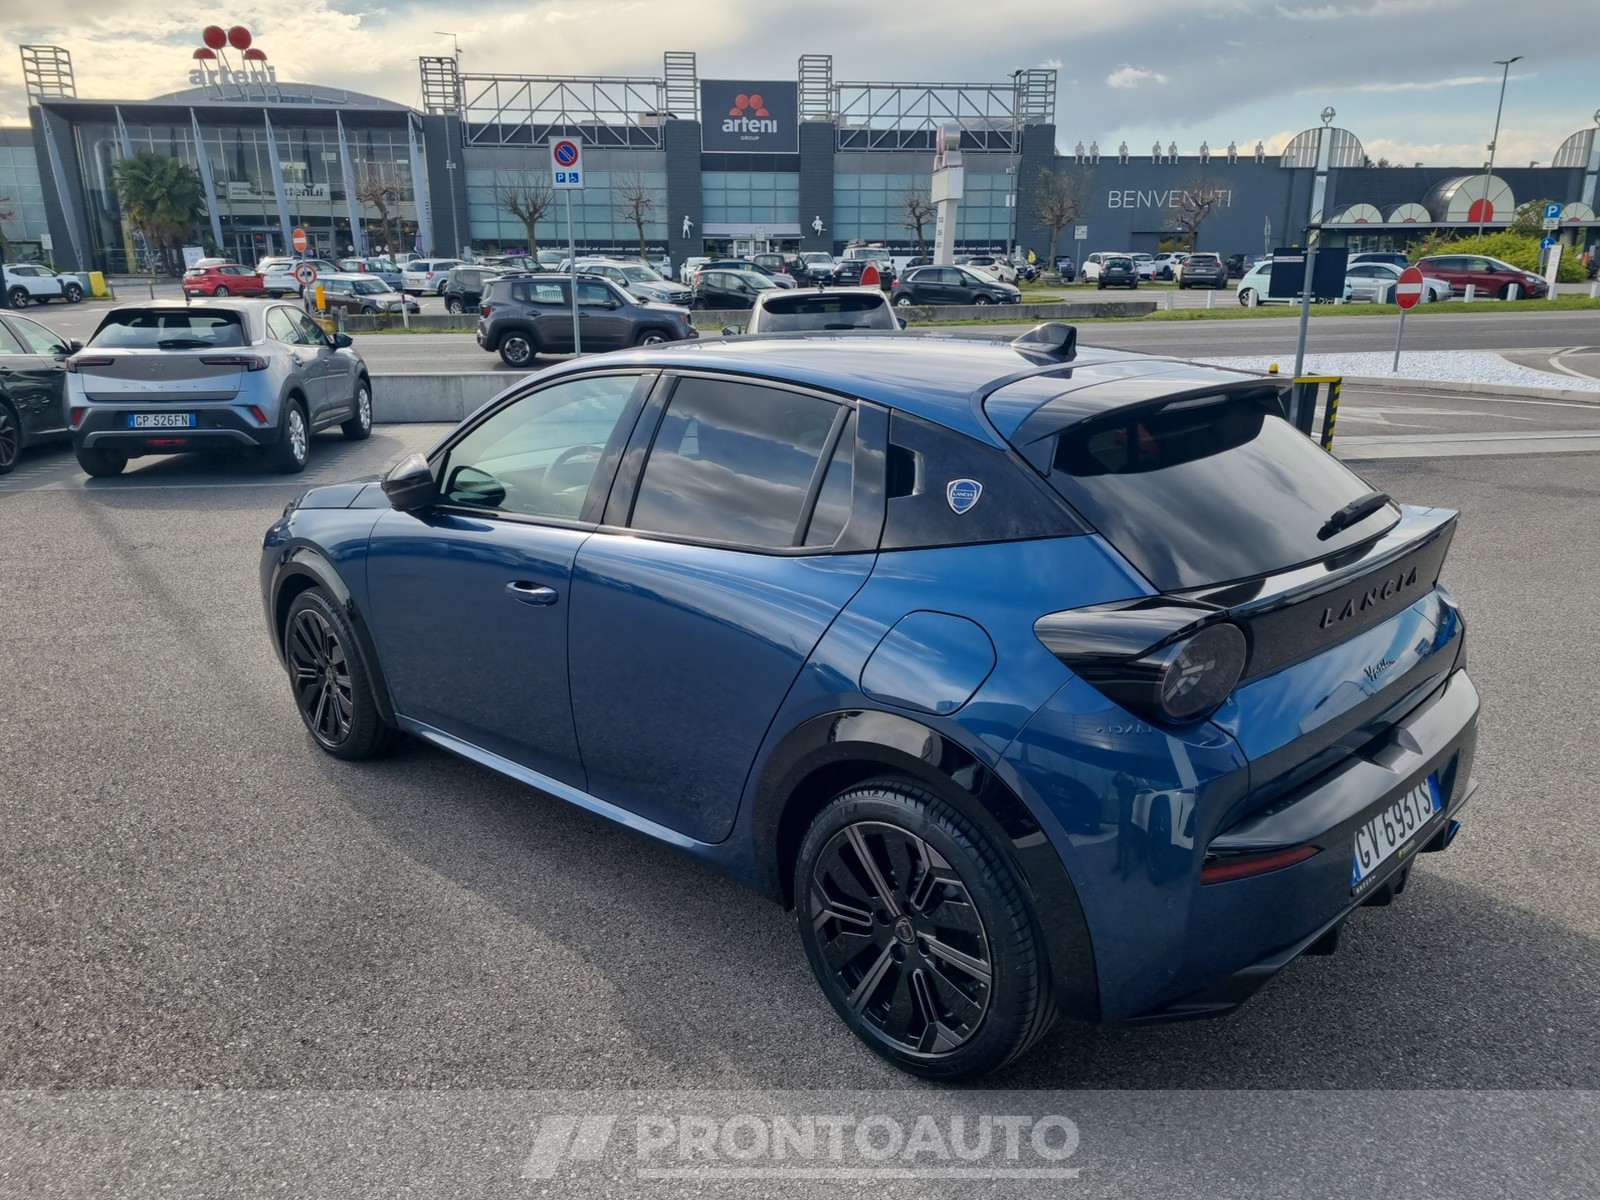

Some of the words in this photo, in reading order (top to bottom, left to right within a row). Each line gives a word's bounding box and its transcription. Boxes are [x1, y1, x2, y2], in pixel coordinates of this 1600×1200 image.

[189, 66, 276, 86] arteni
[722, 116, 778, 133] arteni
[285, 187, 323, 197] rteni.it
[1108, 190, 1232, 208] BENVENUTI
[1547, 205, 1558, 217] P
[1319, 566, 1418, 629] LANCIA
